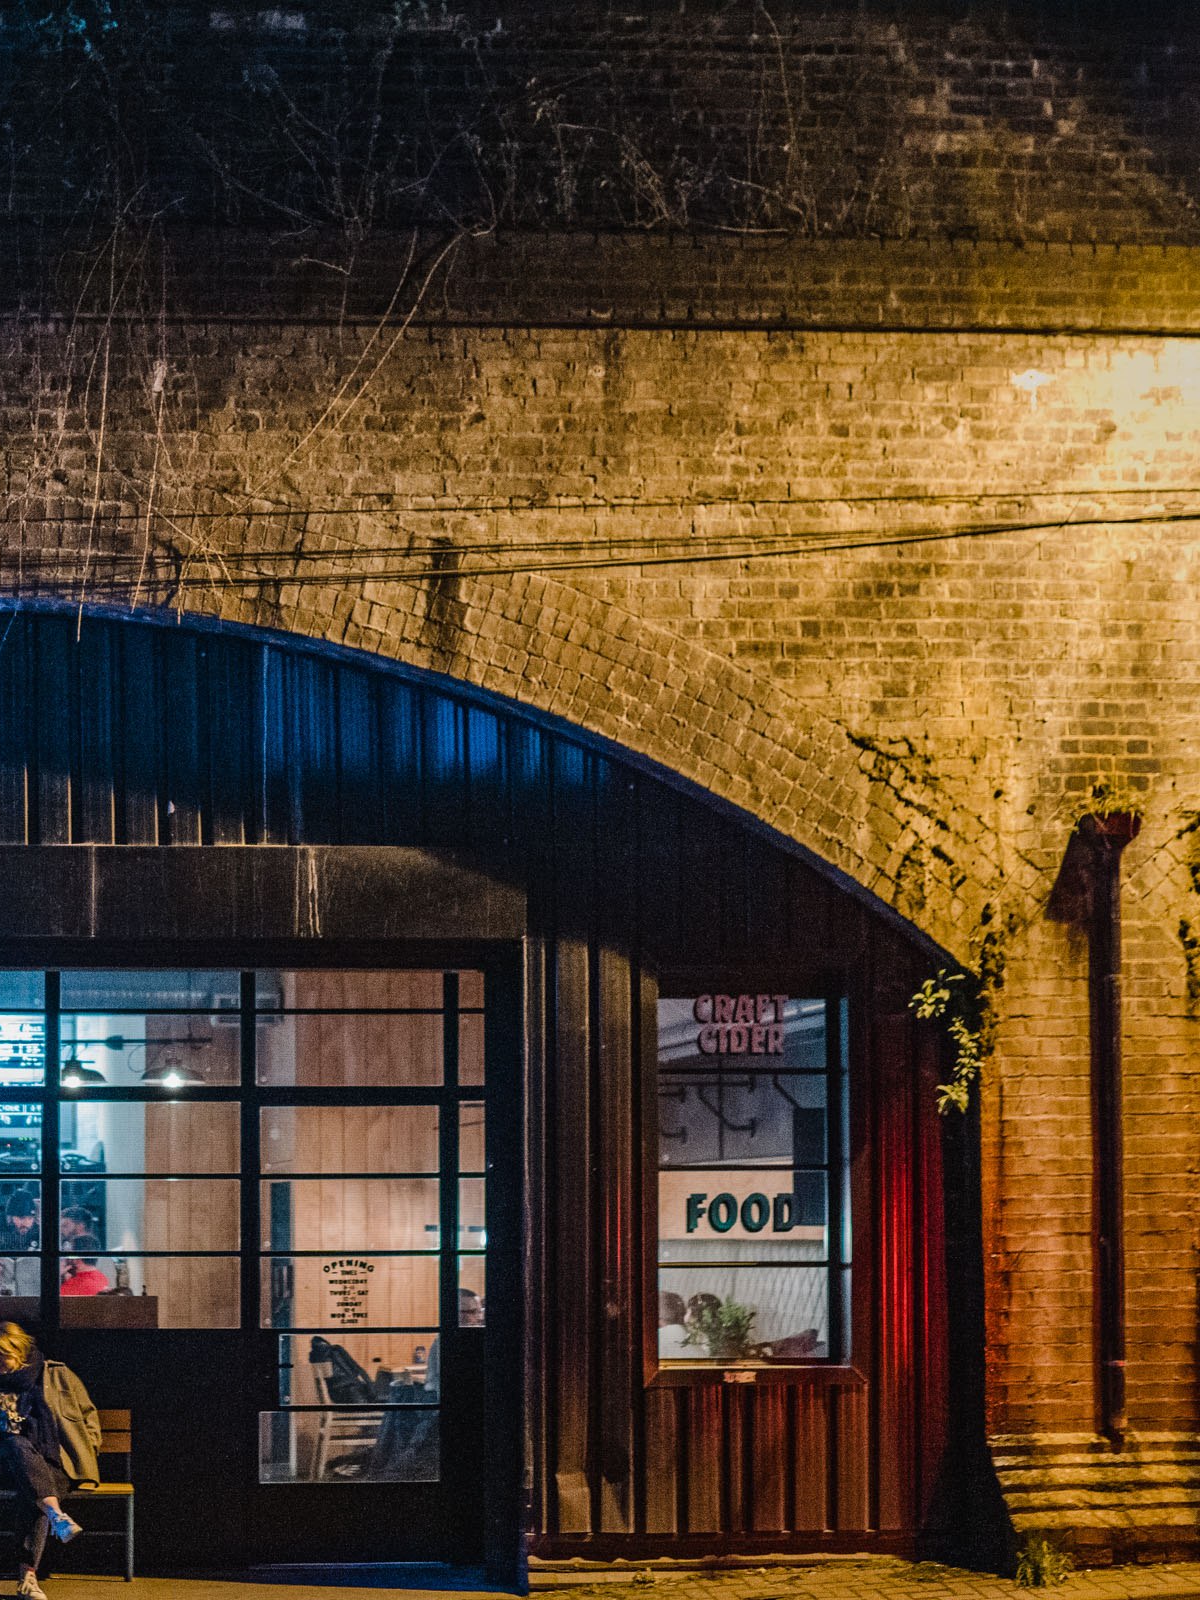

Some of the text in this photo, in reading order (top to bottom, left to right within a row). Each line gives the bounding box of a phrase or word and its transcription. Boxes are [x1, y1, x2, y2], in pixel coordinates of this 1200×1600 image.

[693, 993, 789, 1025] CRAFT
[696, 1024, 785, 1056] CIDER
[685, 1192, 796, 1233] FOOD
[323, 1260, 374, 1272] OPENING
